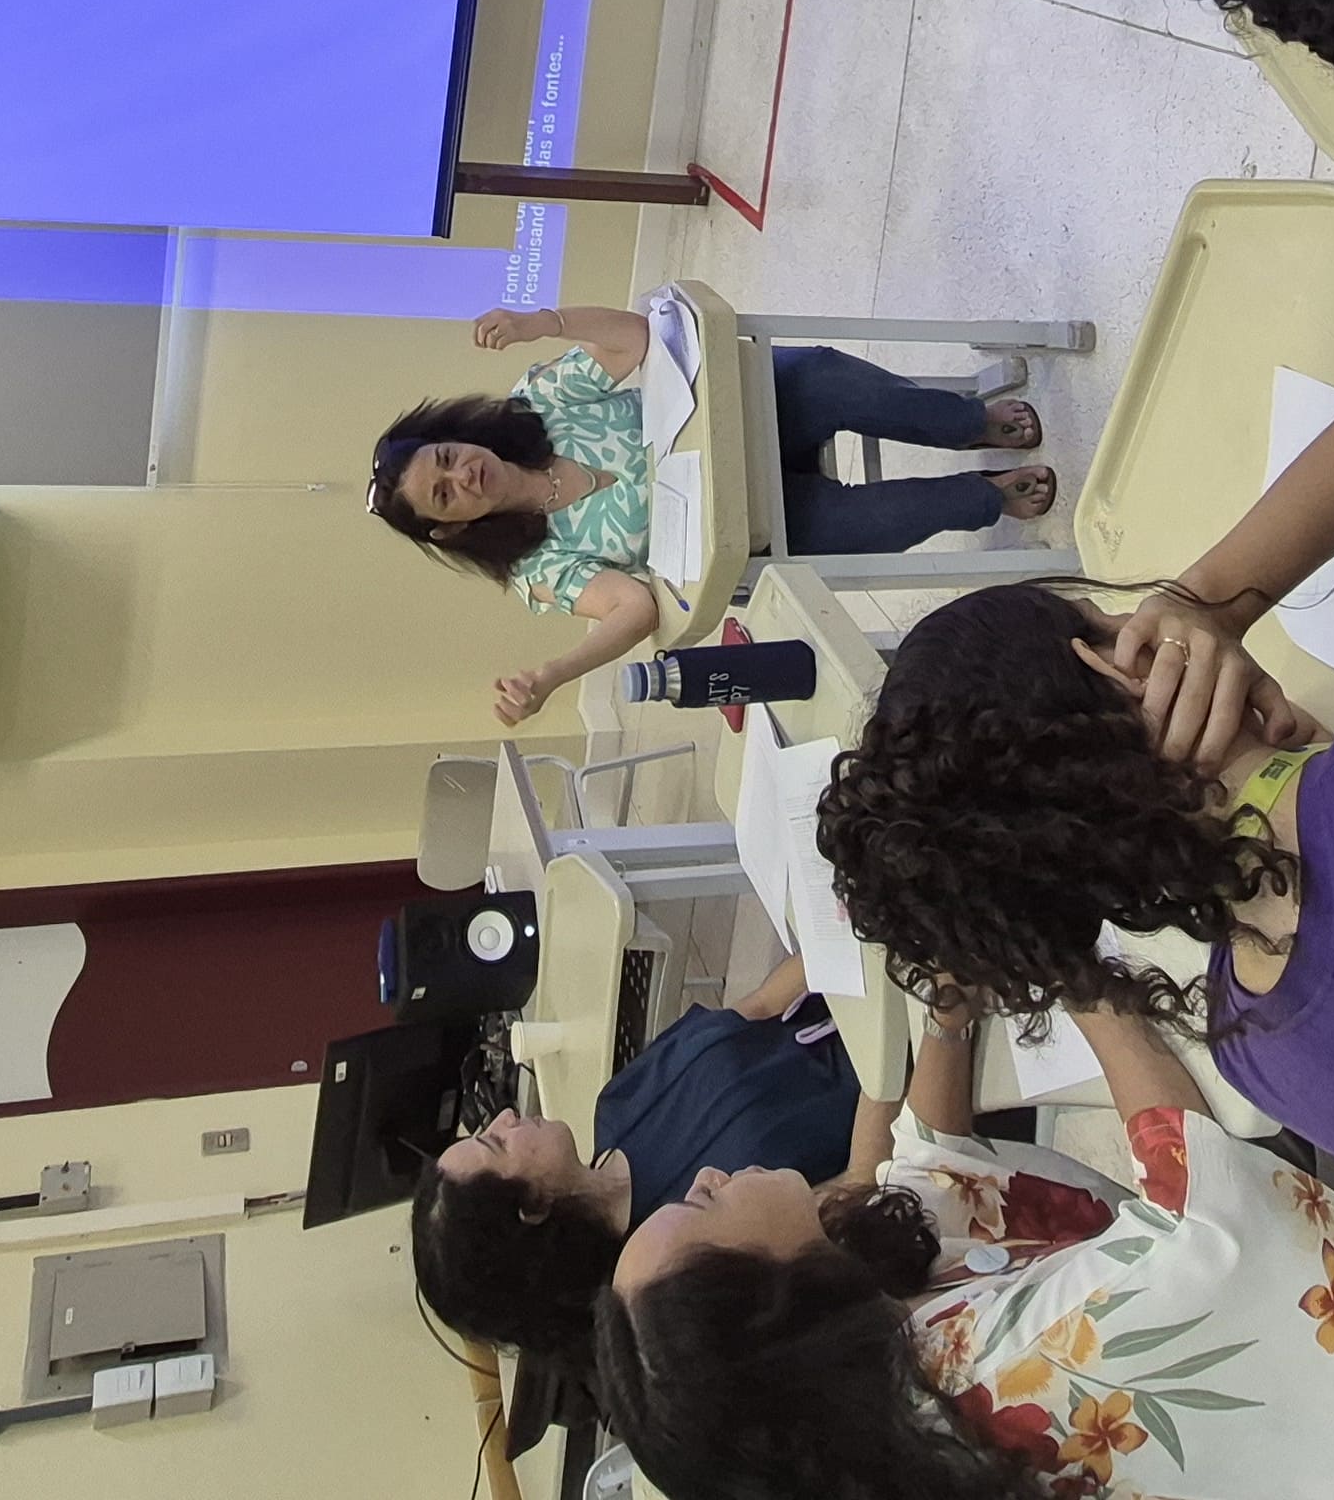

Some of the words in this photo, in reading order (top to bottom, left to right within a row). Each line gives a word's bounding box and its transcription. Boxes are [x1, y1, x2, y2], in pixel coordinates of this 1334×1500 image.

[541, 34, 565, 107] fontes...
[541, 113, 556, 134] as
[521, 202, 546, 306] Pesquisand
